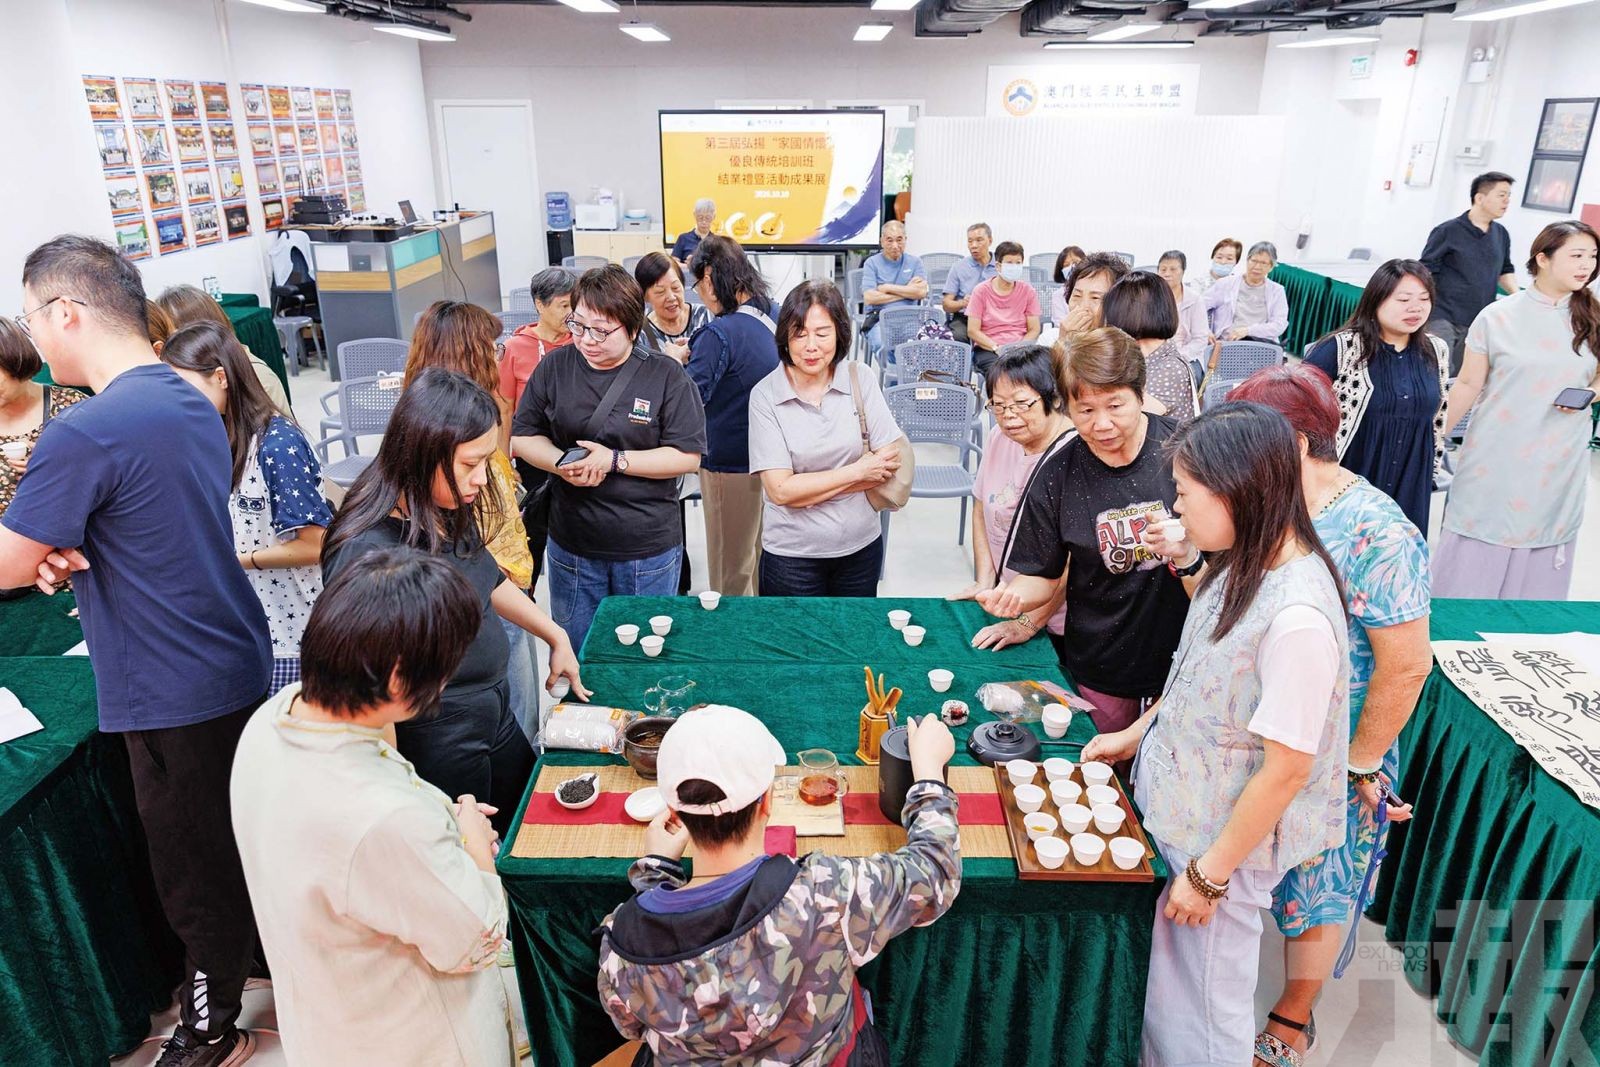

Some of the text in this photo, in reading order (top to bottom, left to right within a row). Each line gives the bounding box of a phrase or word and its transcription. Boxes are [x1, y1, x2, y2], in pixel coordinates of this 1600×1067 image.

[729, 155, 815, 168] 優良傳統培訓班
[717, 172, 826, 186] 結業禮暨活動成果展
